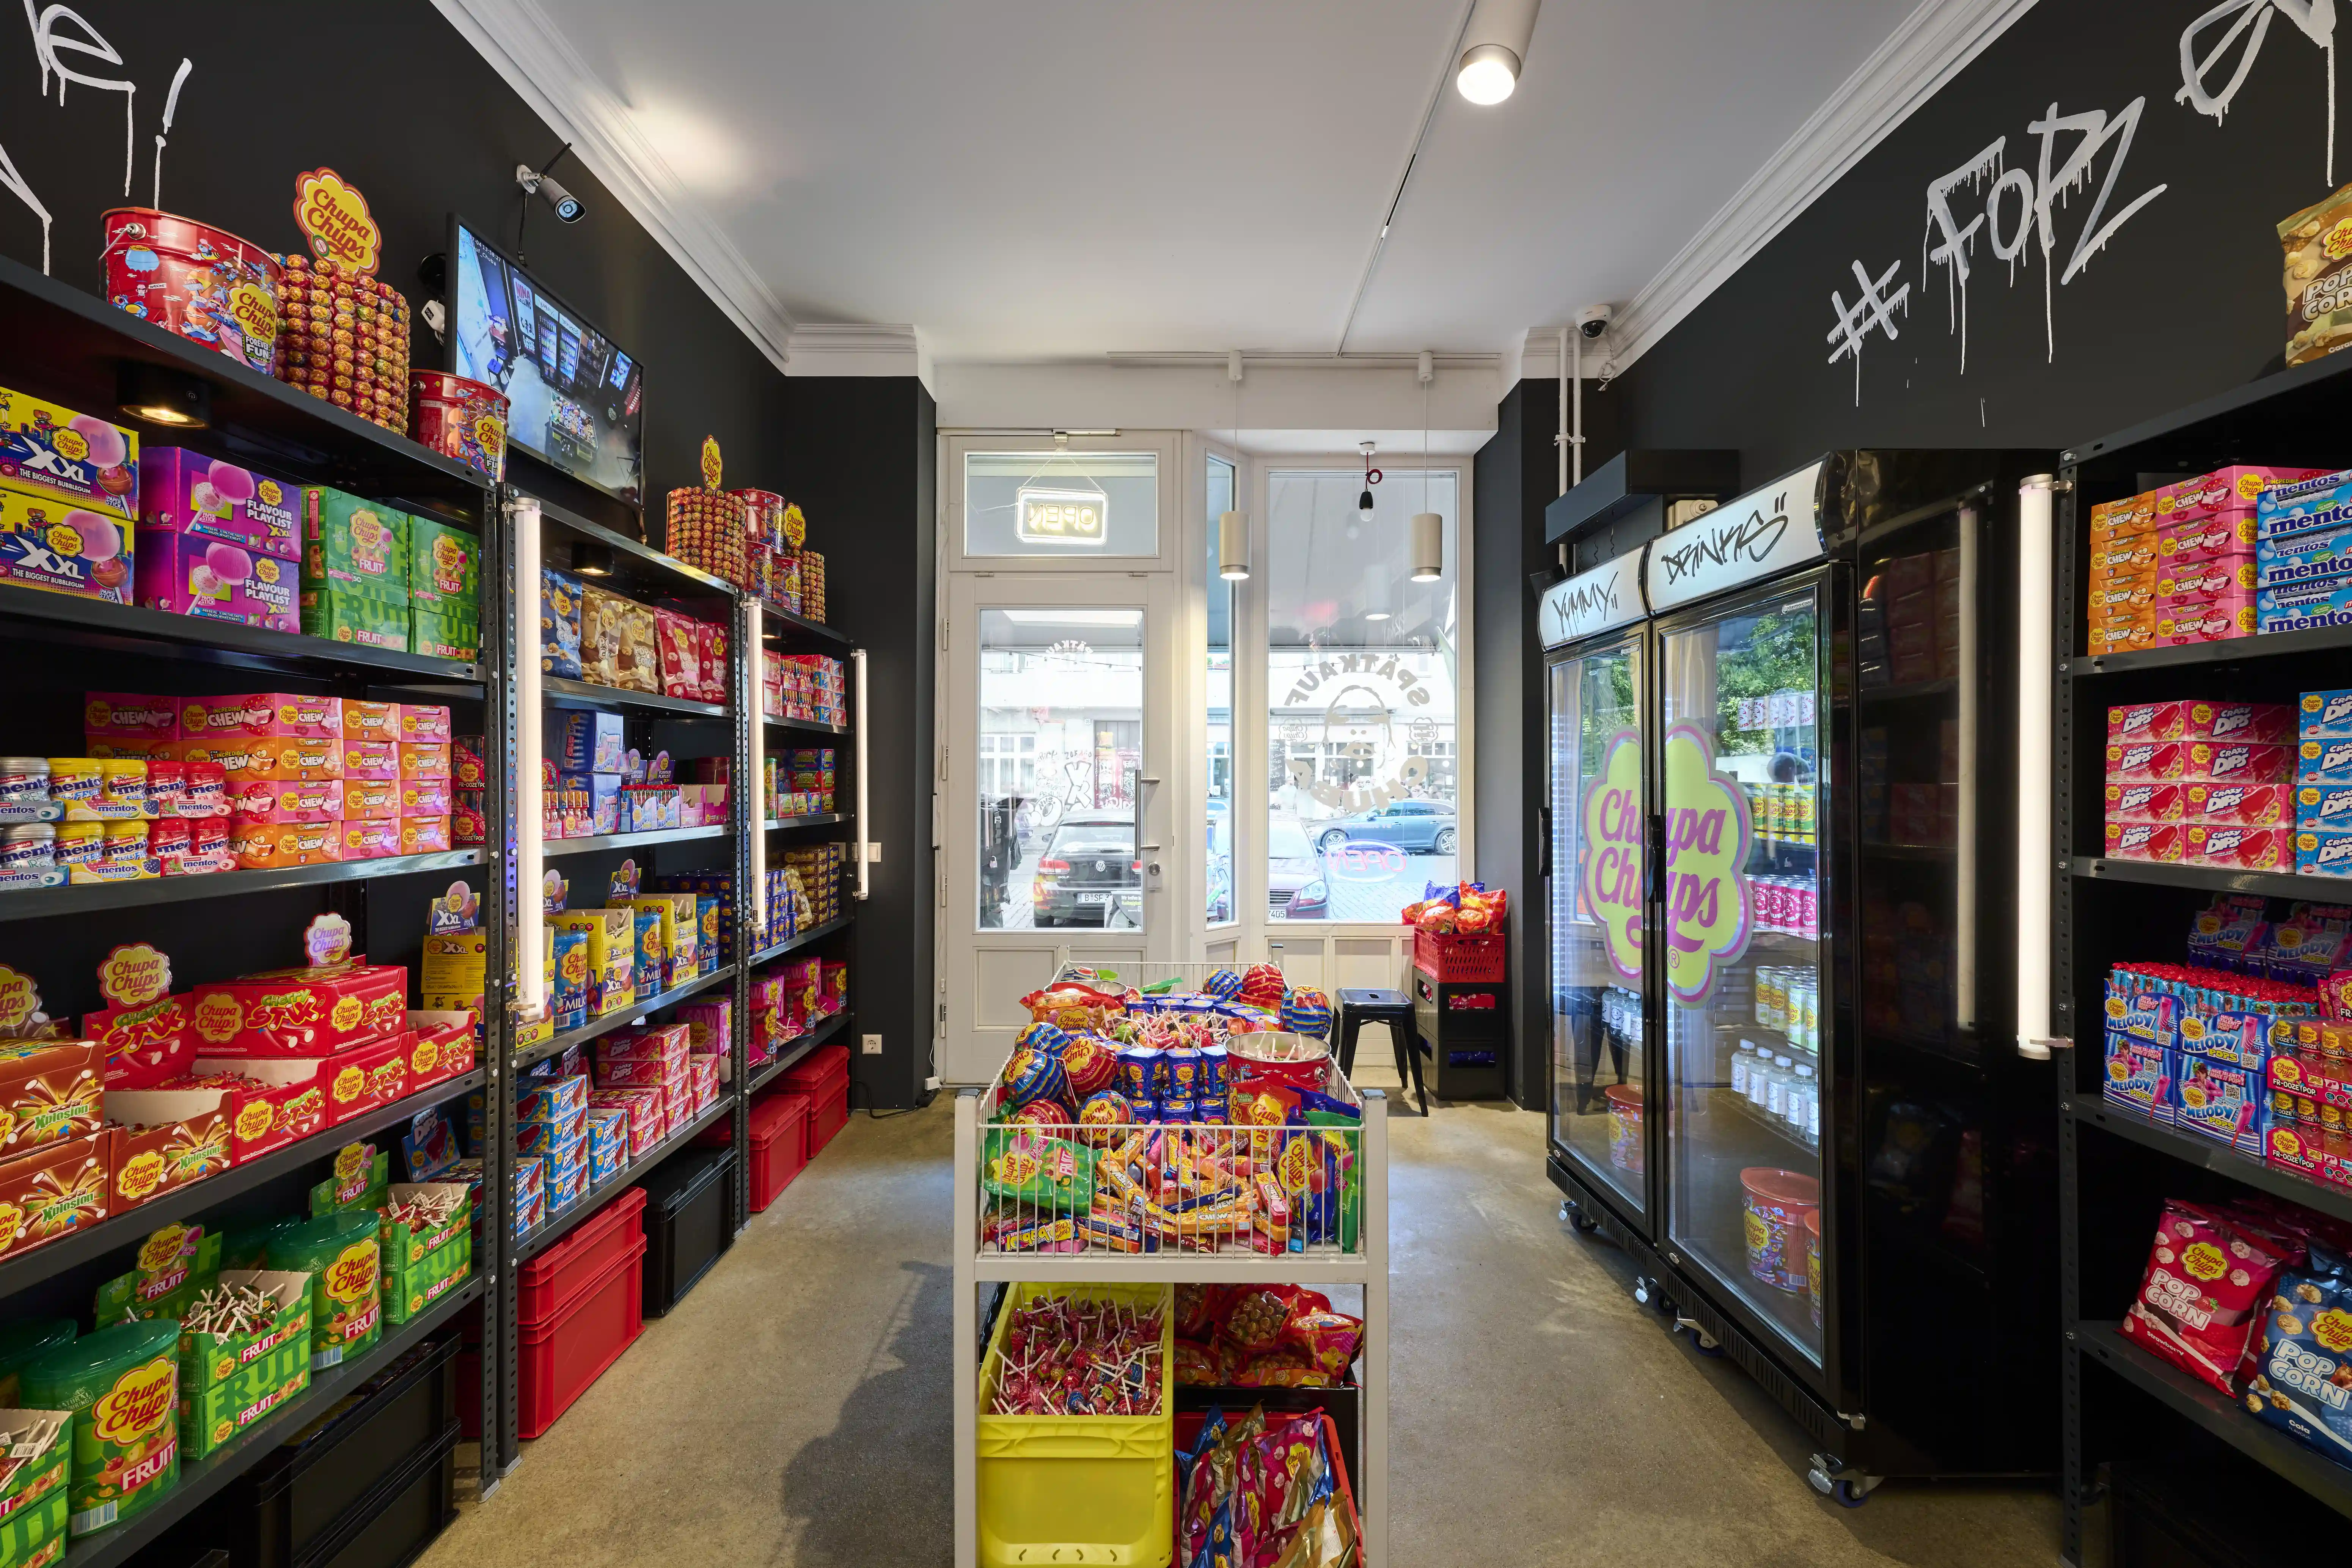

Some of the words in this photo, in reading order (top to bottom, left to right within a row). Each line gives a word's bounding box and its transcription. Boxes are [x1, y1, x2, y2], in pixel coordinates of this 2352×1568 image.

[314, 189, 370, 240] Chupa
[308, 207, 365, 262] Chups
[515, 282, 530, 300] NINA
[239, 292, 275, 322] Chupa
[517, 297, 531, 309] CALLING
[236, 308, 275, 339] Chups
[245, 344, 269, 360] FUN
[246, 336, 270, 350] FOREVER
[57, 440, 83, 455] Chups
[58, 434, 84, 447] Chupa
[20, 435, 91, 484] XXL
[706, 447, 720, 469] Chupa
[704, 457, 718, 483] Chups
[19, 468, 31, 478] THE
[32, 470, 57, 486] BIGGEST
[57, 478, 91, 494] BUBBLEGUM
[262, 484, 280, 494] Chupa
[107, 496, 121, 504] PAPER
[262, 490, 279, 502] Chups
[2175, 493, 2203, 508] CHEW
[2179, 489, 2201, 499] INCREDIBLE
[247, 500, 292, 520] FLAVOUR
[247, 509, 292, 529] PLAYLIST
[355, 517, 379, 532] Chupa
[2108, 514, 2132, 526] CHEW
[354, 525, 378, 544] Chups
[2177, 535, 2205, 550] CHEW
[436, 550, 456, 565] Chups
[437, 542, 457, 555] Chupa
[360, 559, 385, 574] FRUIT
[439, 578, 460, 592] FRUIT
[1788, 600, 1812, 611] Gastro-Cool
[213, 705, 242, 713] INCREDIBLE
[298, 711, 324, 723] CHEW
[2129, 707, 2155, 718] CRAZY
[207, 710, 245, 727] CHEW
[2122, 712, 2154, 733] DIPS
[2220, 747, 2250, 757] CRAZY
[362, 757, 384, 766] CHEW
[2211, 753, 2250, 776] DIPS
[97, 804, 137, 814] mentos
[1599, 788, 1727, 867] Chupa
[97, 864, 138, 874] mentos
[183, 859, 218, 867] mentos
[614, 882, 628, 893] XXL
[1595, 847, 1721, 952] Chups
[112, 960, 159, 977] Chupa
[676, 955, 688, 968] XXL
[112, 972, 160, 997] Chups
[606, 980, 622, 994] XXL
[261, 989, 311, 1007] CHERRY
[246, 998, 319, 1031] STIX
[2107, 1014, 2156, 1029] MELODY
[2129, 1027, 2154, 1038] POPS
[2184, 1034, 2239, 1052] MELODY
[2208, 1049, 2238, 1061] POPS
[2276, 1068, 2295, 1078] Chups
[2277, 1062, 2296, 1072] Chupa
[338, 1073, 360, 1085] Chupa
[2273, 1078, 2300, 1091] FR-OOZE
[2303, 1086, 2316, 1095] POP
[48, 1098, 81, 1114] cola
[368, 1101, 380, 1110] candies
[34, 1105, 89, 1132] Xplosion
[1035, 1144, 1046, 1158] STIEL
[1291, 1143, 1315, 1175] Chupa
[2273, 1150, 2299, 1164] FR-OOZE
[2302, 1161, 2314, 1169] POP
[1060, 1150, 1072, 1175] FRUIT
[1281, 1156, 1305, 1184] Chups
[342, 1182, 366, 1202] FRUIT
[42, 1192, 94, 1223] Xplosion
[428, 1227, 450, 1249] FRUIT
[335, 1249, 377, 1278] Chupa
[2185, 1255, 2219, 1275] Chups
[2192, 1246, 2224, 1268] Chupa
[147, 1271, 185, 1299] FRUIT
[333, 1265, 377, 1295] Chups
[427, 1277, 449, 1299] FRUIT
[2150, 1268, 2201, 1301] POP
[2146, 1284, 2211, 1331] CORN
[241, 1333, 277, 1362] FRUIT
[2146, 1331, 2184, 1356] Strawberry
[2274, 1339, 2336, 1378] POP
[112, 1374, 172, 1413] Chupa
[2269, 1358, 2350, 1411] CORN
[105, 1391, 171, 1432] Chups
[2289, 1419, 2310, 1434] Cola
[122, 1442, 176, 1491] FRUIT
